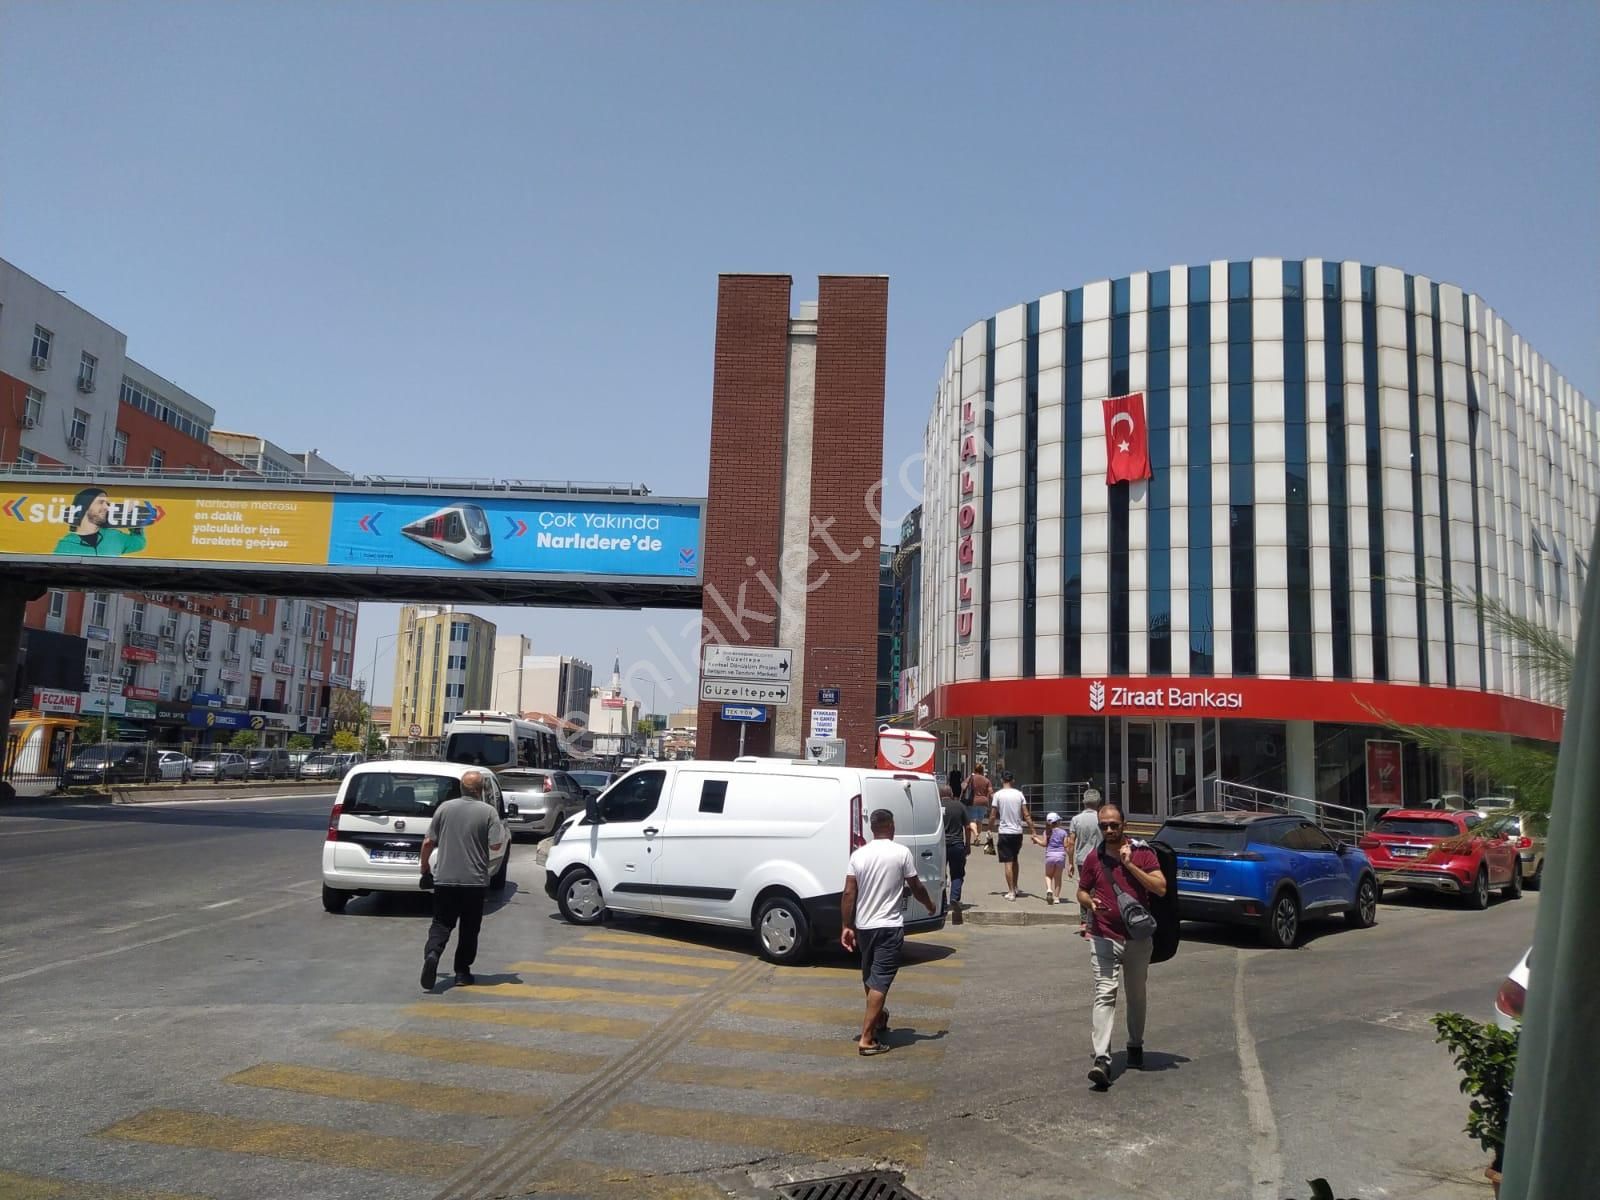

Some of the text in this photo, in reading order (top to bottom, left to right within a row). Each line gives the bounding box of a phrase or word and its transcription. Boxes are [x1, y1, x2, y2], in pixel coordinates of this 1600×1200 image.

[28, 495, 140, 527] sürtli
[251, 500, 298, 512] metrosu
[194, 511, 209, 520] en
[538, 511, 660, 531] Çok Yakında
[958, 401, 976, 637] LALOĞLU
[192, 522, 281, 537] yolculuklar için
[191, 534, 289, 550] harekete geçiyor
[725, 656, 761, 664] Güzeltepe
[42, 694, 76, 706] ECZANE
[704, 685, 775, 700] Güzeltepe
[1111, 687, 1242, 709] Ziraat Bankası
